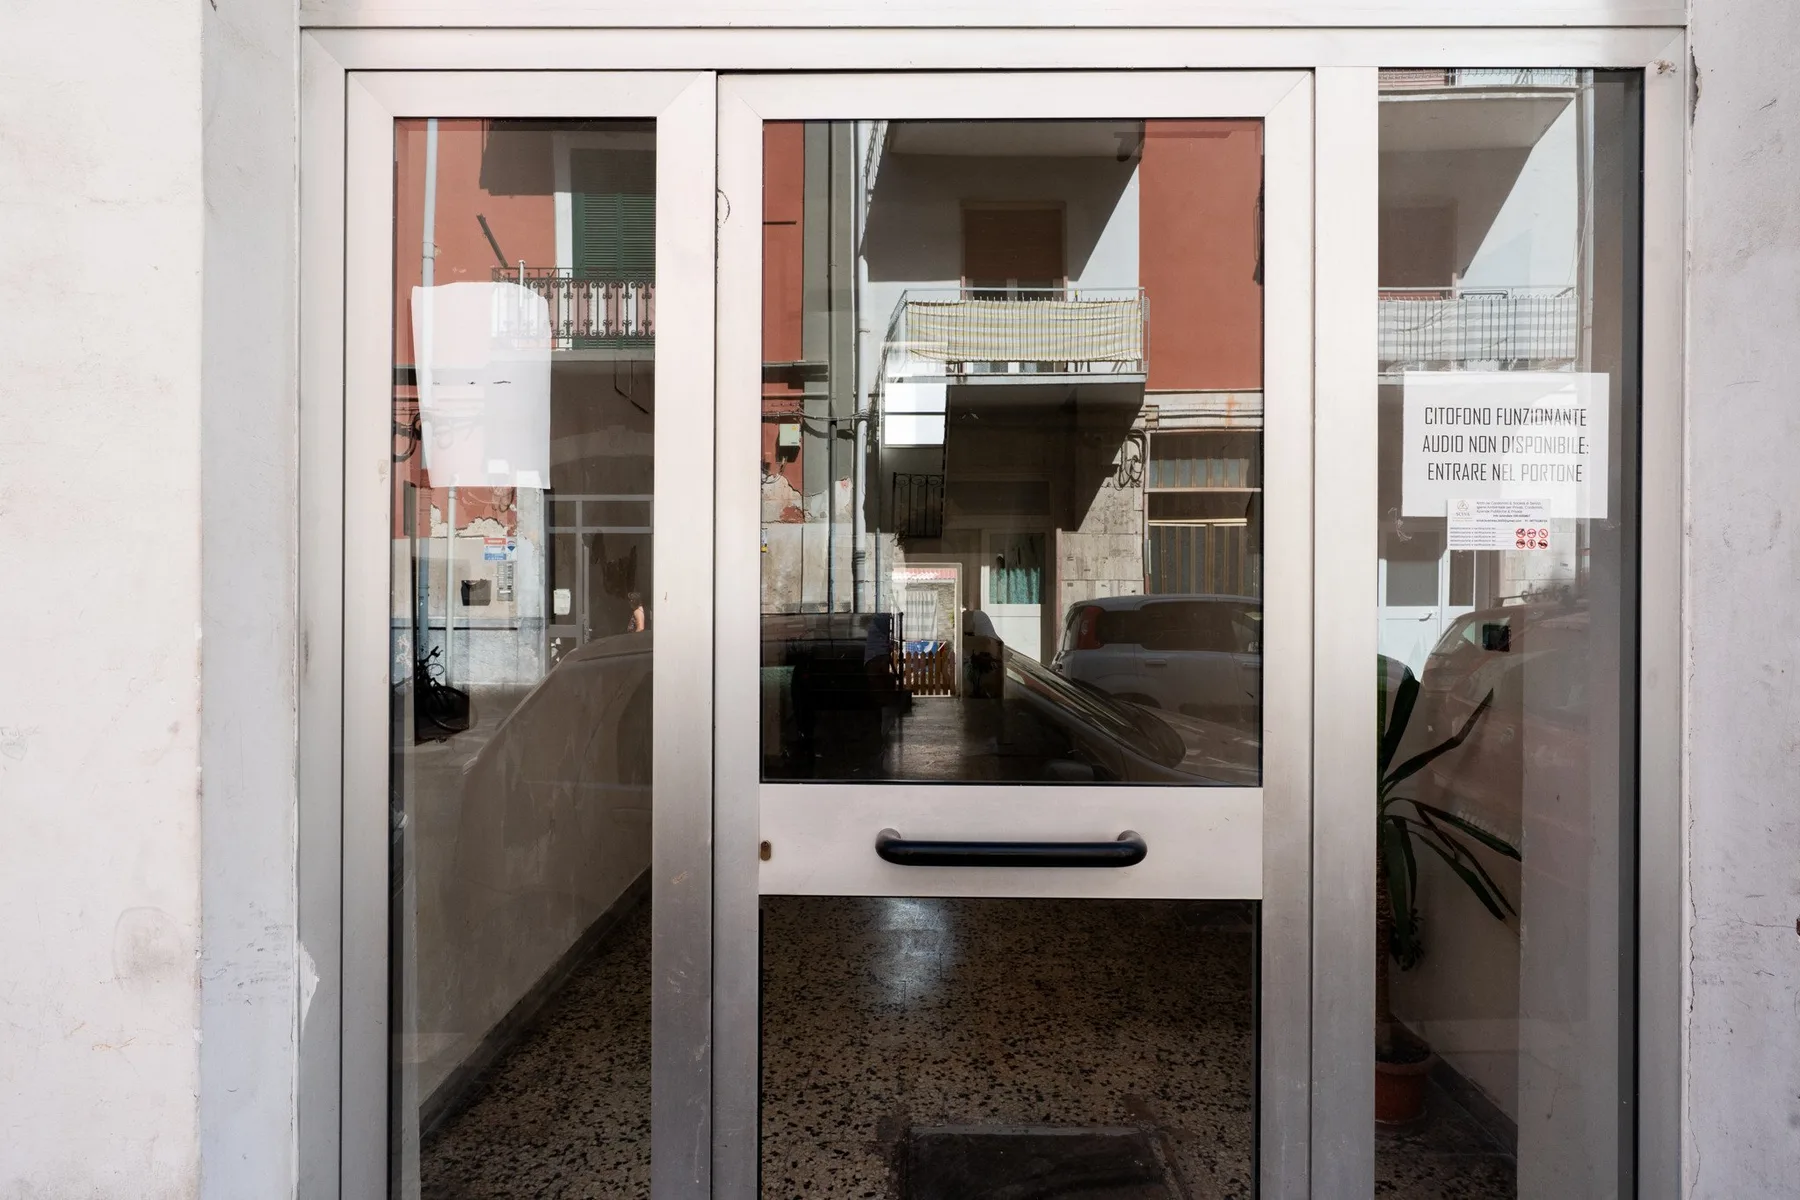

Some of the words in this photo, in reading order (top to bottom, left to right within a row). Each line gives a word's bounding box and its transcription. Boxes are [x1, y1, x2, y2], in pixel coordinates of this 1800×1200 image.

[1424, 407, 1491, 426] CITOFONO
[1496, 408, 1587, 427] FUNZIONANTE
[1422, 435, 1464, 453] AUDIO
[1469, 435, 1497, 454] NON
[1428, 462, 1487, 481] ENTRARE
[1492, 463, 1516, 482] NEL
[1521, 463, 1583, 483] PORTONE
